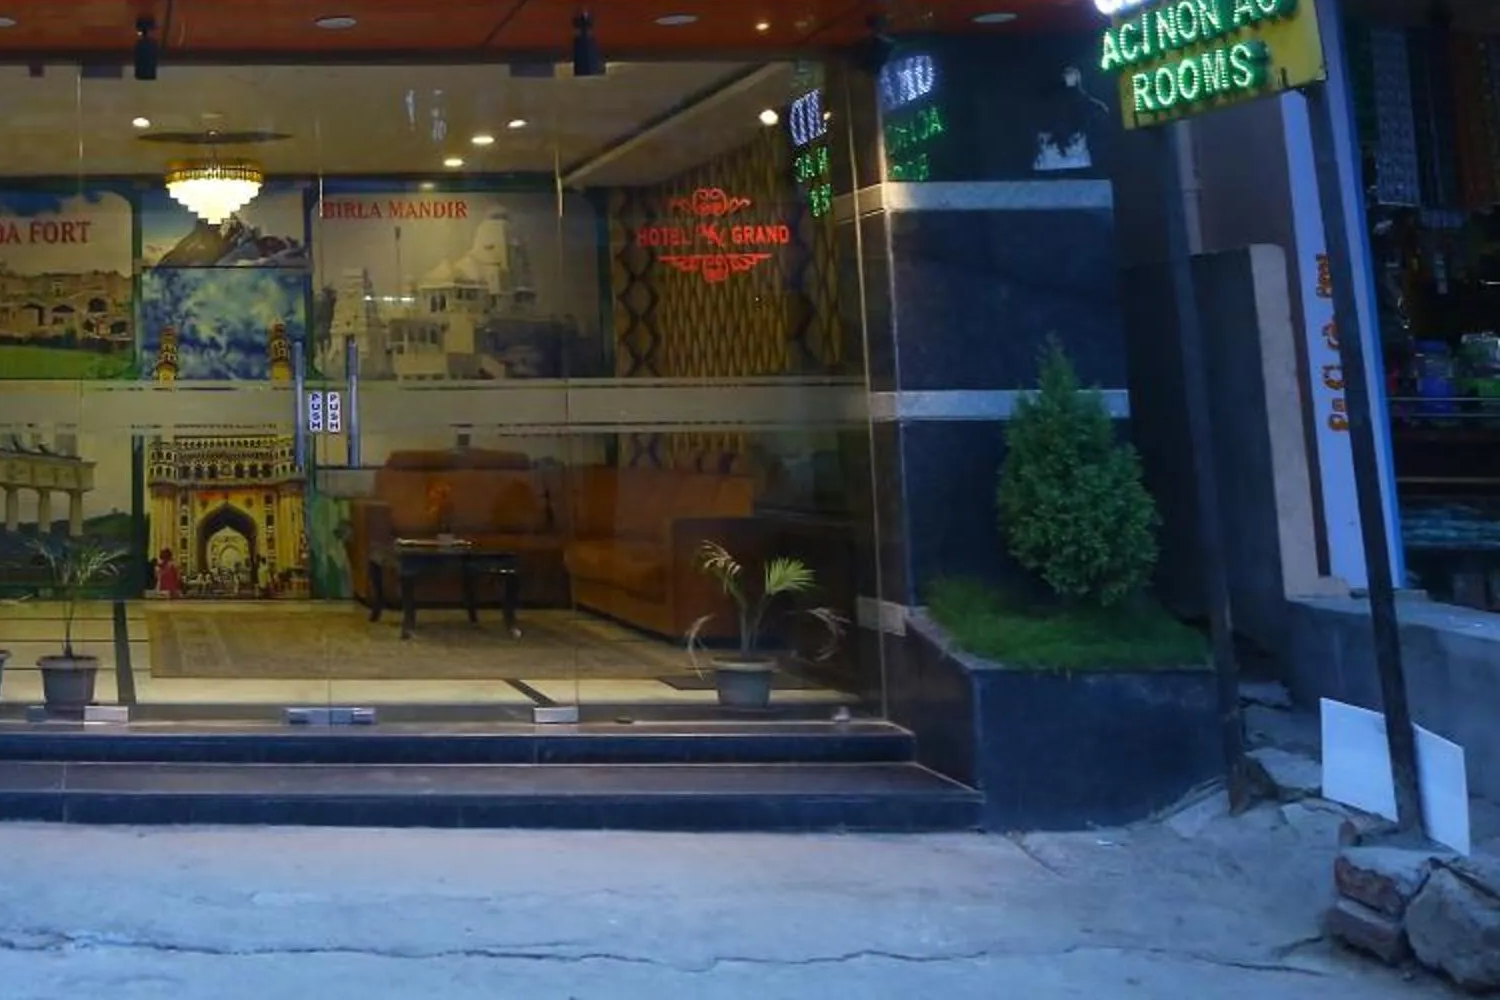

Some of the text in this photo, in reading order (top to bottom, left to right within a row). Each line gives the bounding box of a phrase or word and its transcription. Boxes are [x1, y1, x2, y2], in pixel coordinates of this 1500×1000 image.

[1132, 43, 1256, 113] ROOMS
[323, 201, 467, 220] BIRLA MANDIR
[29, 220, 92, 244] FORT
[637, 225, 692, 246] HOTEL
[731, 224, 790, 245] GRAND
[311, 393, 321, 429] PUSH
[329, 393, 339, 429] PUSH
